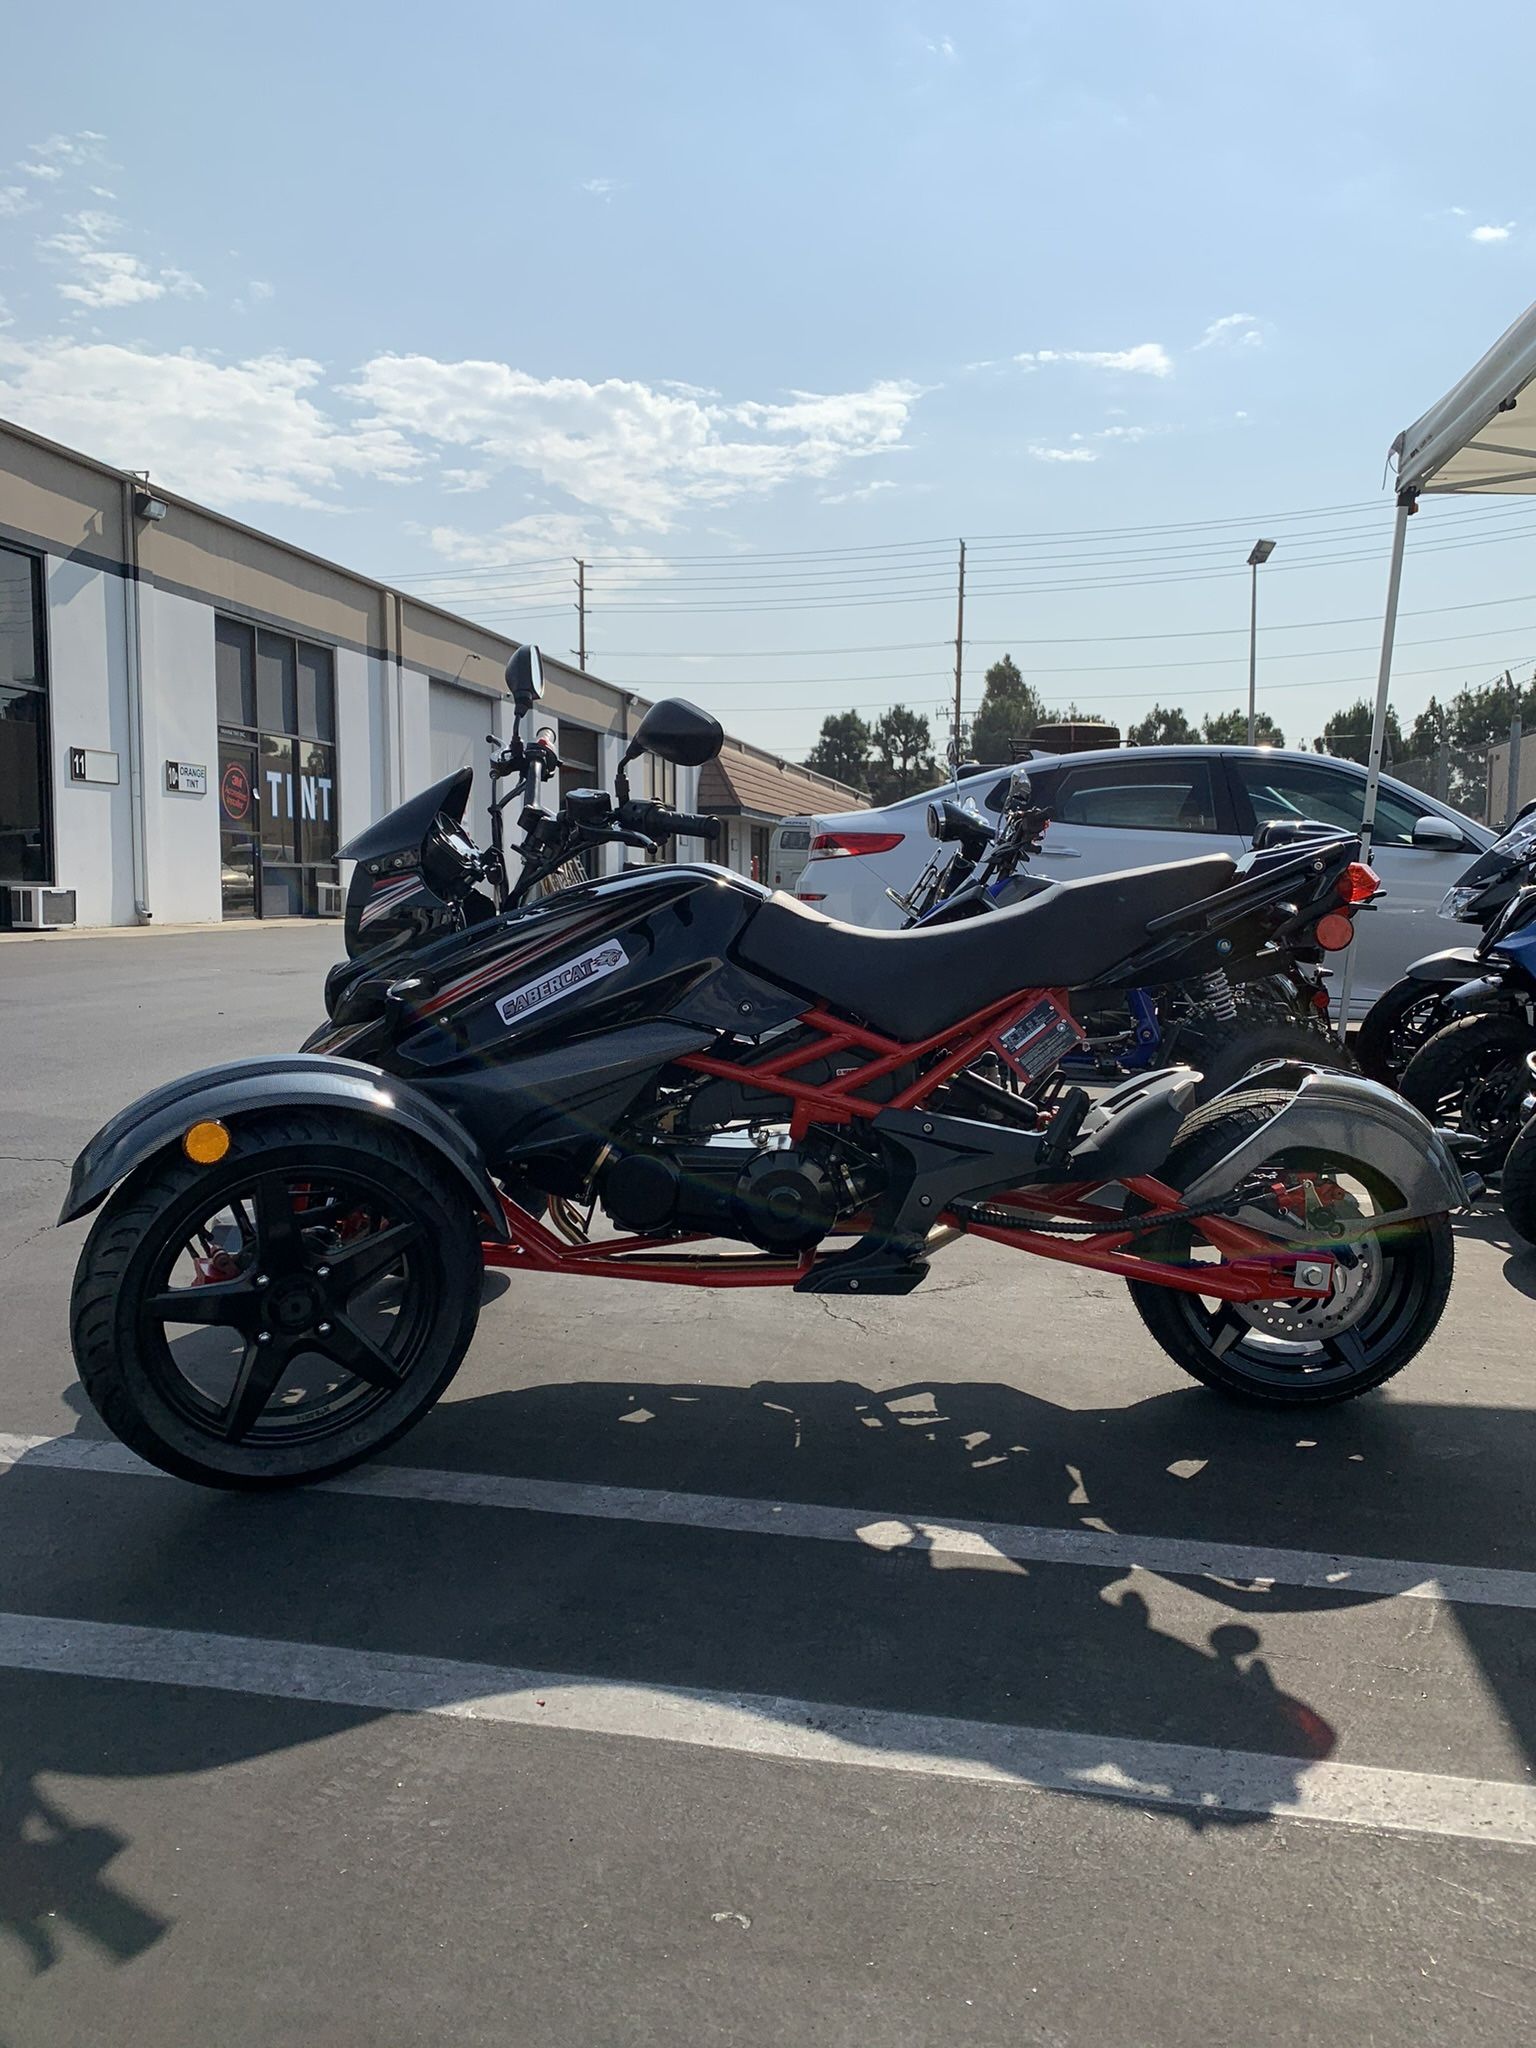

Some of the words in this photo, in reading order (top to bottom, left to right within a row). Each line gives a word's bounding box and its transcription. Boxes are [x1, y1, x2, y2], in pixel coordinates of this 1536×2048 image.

[74, 754, 85, 775] 11
[180, 766, 205, 779] ORANGE
[186, 779, 199, 789] TINT
[266, 771, 332, 821] TINT
[502, 958, 599, 1020] SABERCAT
